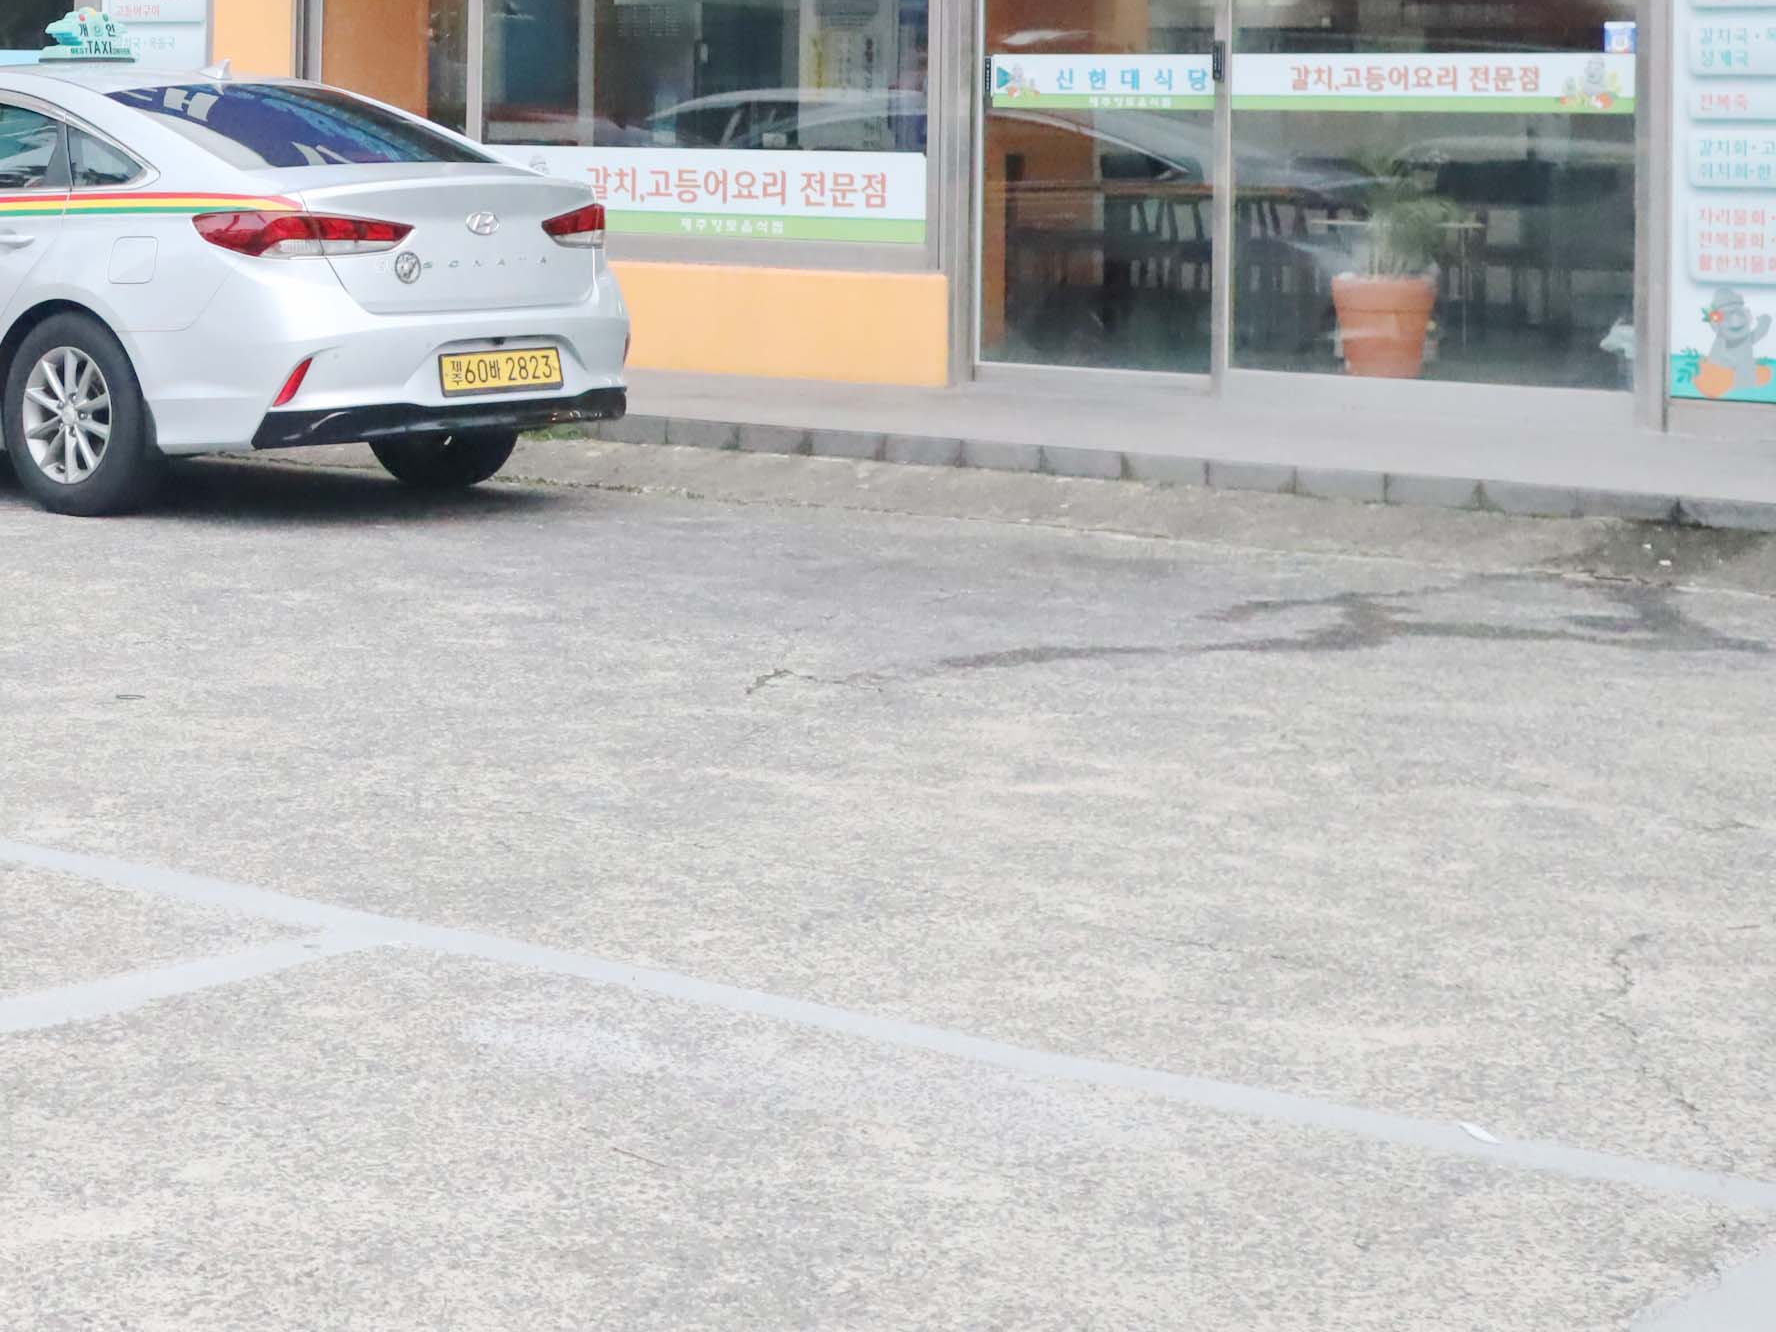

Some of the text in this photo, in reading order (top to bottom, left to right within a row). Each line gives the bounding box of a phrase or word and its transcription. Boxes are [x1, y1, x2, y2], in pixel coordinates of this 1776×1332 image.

[87, 40, 114, 55] TAXI
[1467, 64, 1542, 93] 전문점
[798, 169, 889, 209] 전문점
[504, 354, 554, 382] 2823
